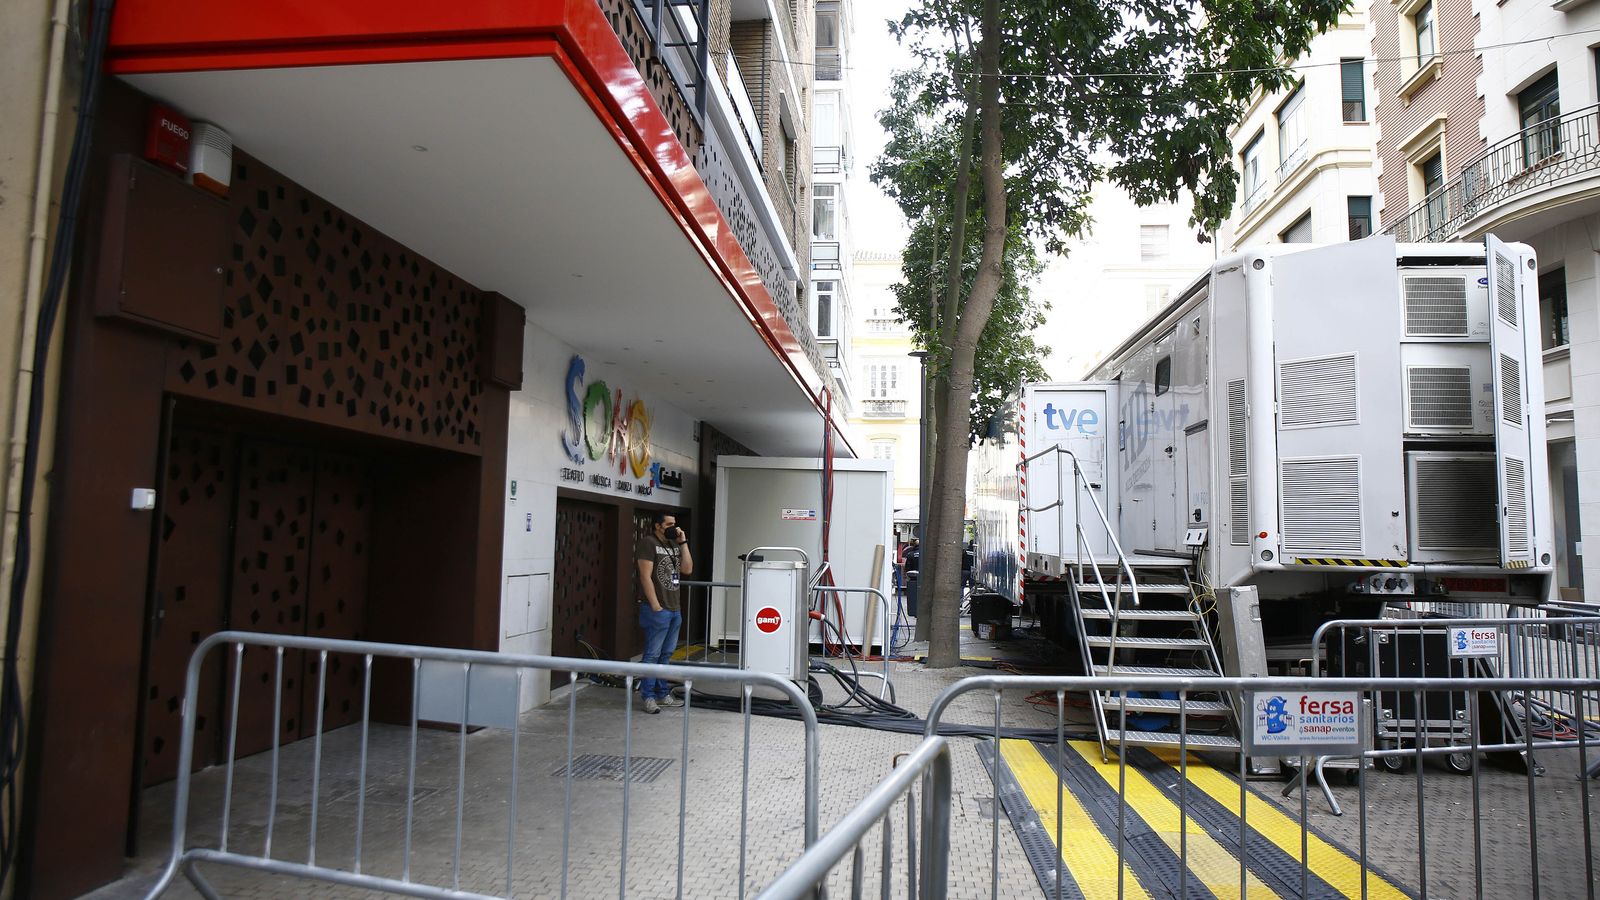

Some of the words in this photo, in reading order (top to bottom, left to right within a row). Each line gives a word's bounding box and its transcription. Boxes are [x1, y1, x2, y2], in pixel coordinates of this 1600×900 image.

[160, 118, 189, 140] FUEGO
[561, 354, 653, 480] SOHO
[1043, 402, 1099, 435] tve
[561, 466, 585, 483] TEATRO
[1471, 630, 1496, 640] fersa
[1299, 695, 1354, 715] fersa
[1299, 713, 1355, 724] sanitarios
[1303, 725, 1332, 734] sanap
